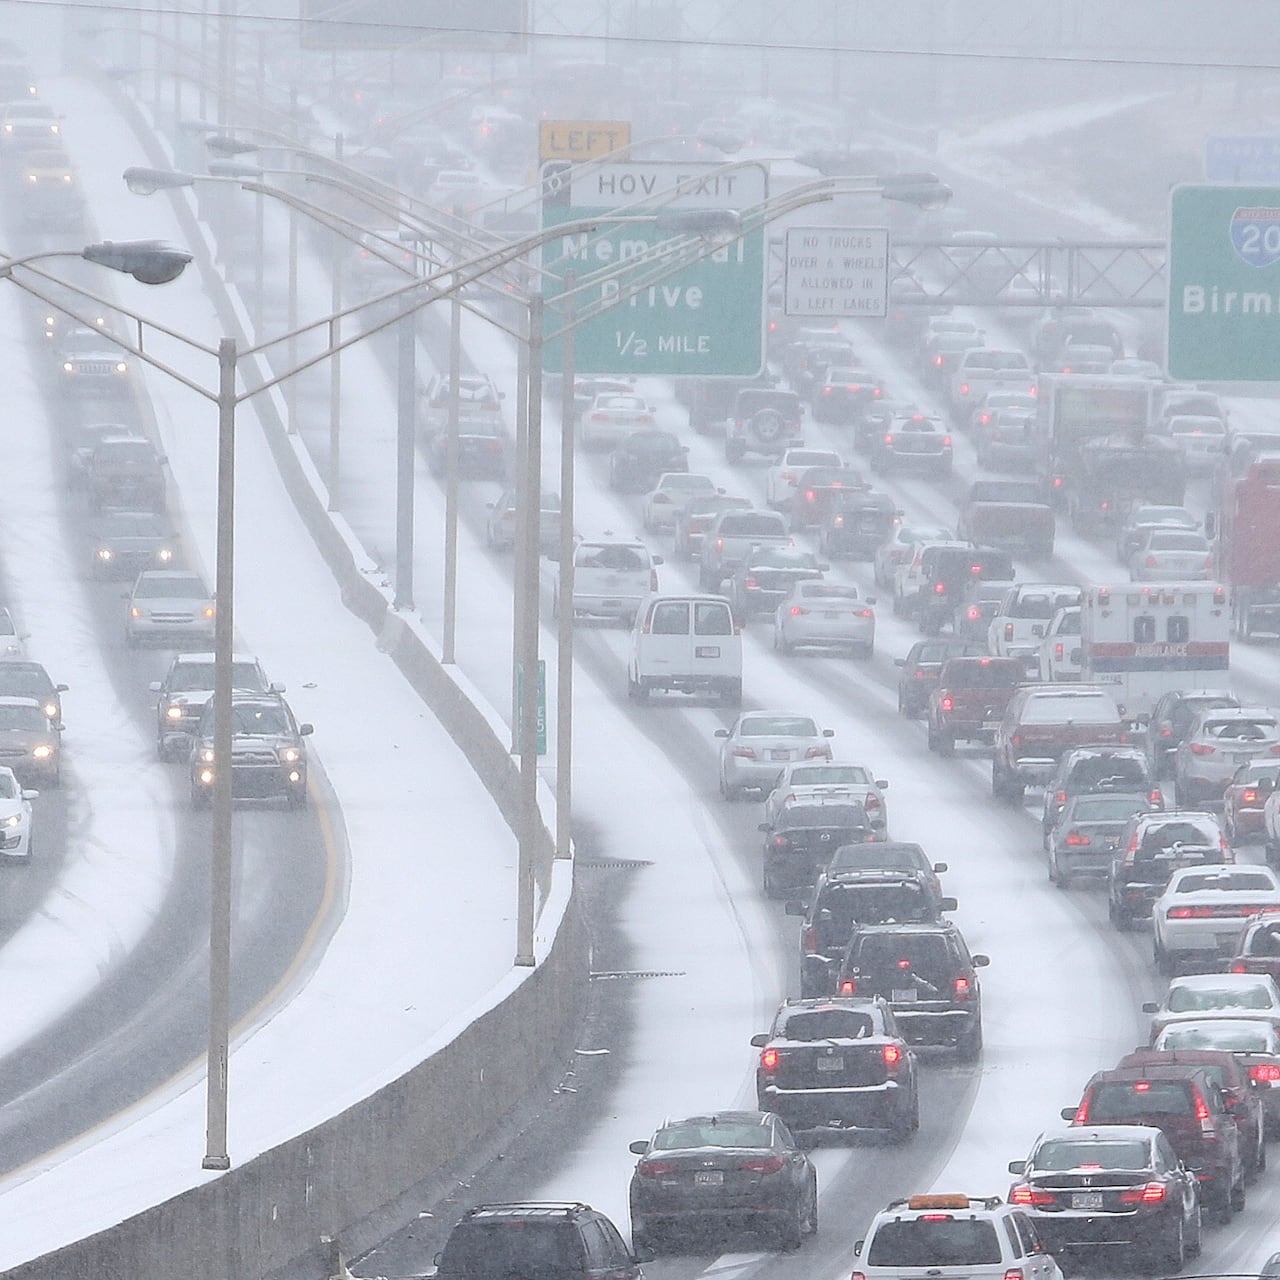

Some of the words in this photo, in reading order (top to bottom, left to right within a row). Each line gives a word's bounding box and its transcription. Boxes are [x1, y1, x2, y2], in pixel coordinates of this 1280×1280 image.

[550, 130, 619, 152] LEFT
[599, 174, 657, 195] HOV
[676, 175, 738, 196] EXIT
[803, 236, 818, 248] NO
[829, 236, 872, 249] TRUCKS
[790, 256, 817, 269] OVER
[842, 256, 884, 270] WHEELS
[800, 277, 853, 289] ALLOWED
[862, 278, 873, 289] IN
[601, 280, 704, 308] Drive
[808, 297, 835, 310] LEFT
[843, 298, 881, 310] LANES
[615, 331, 649, 356] 1/2
[658, 335, 710, 353] MILE
[1135, 644, 1188, 657] AMBULANCE
